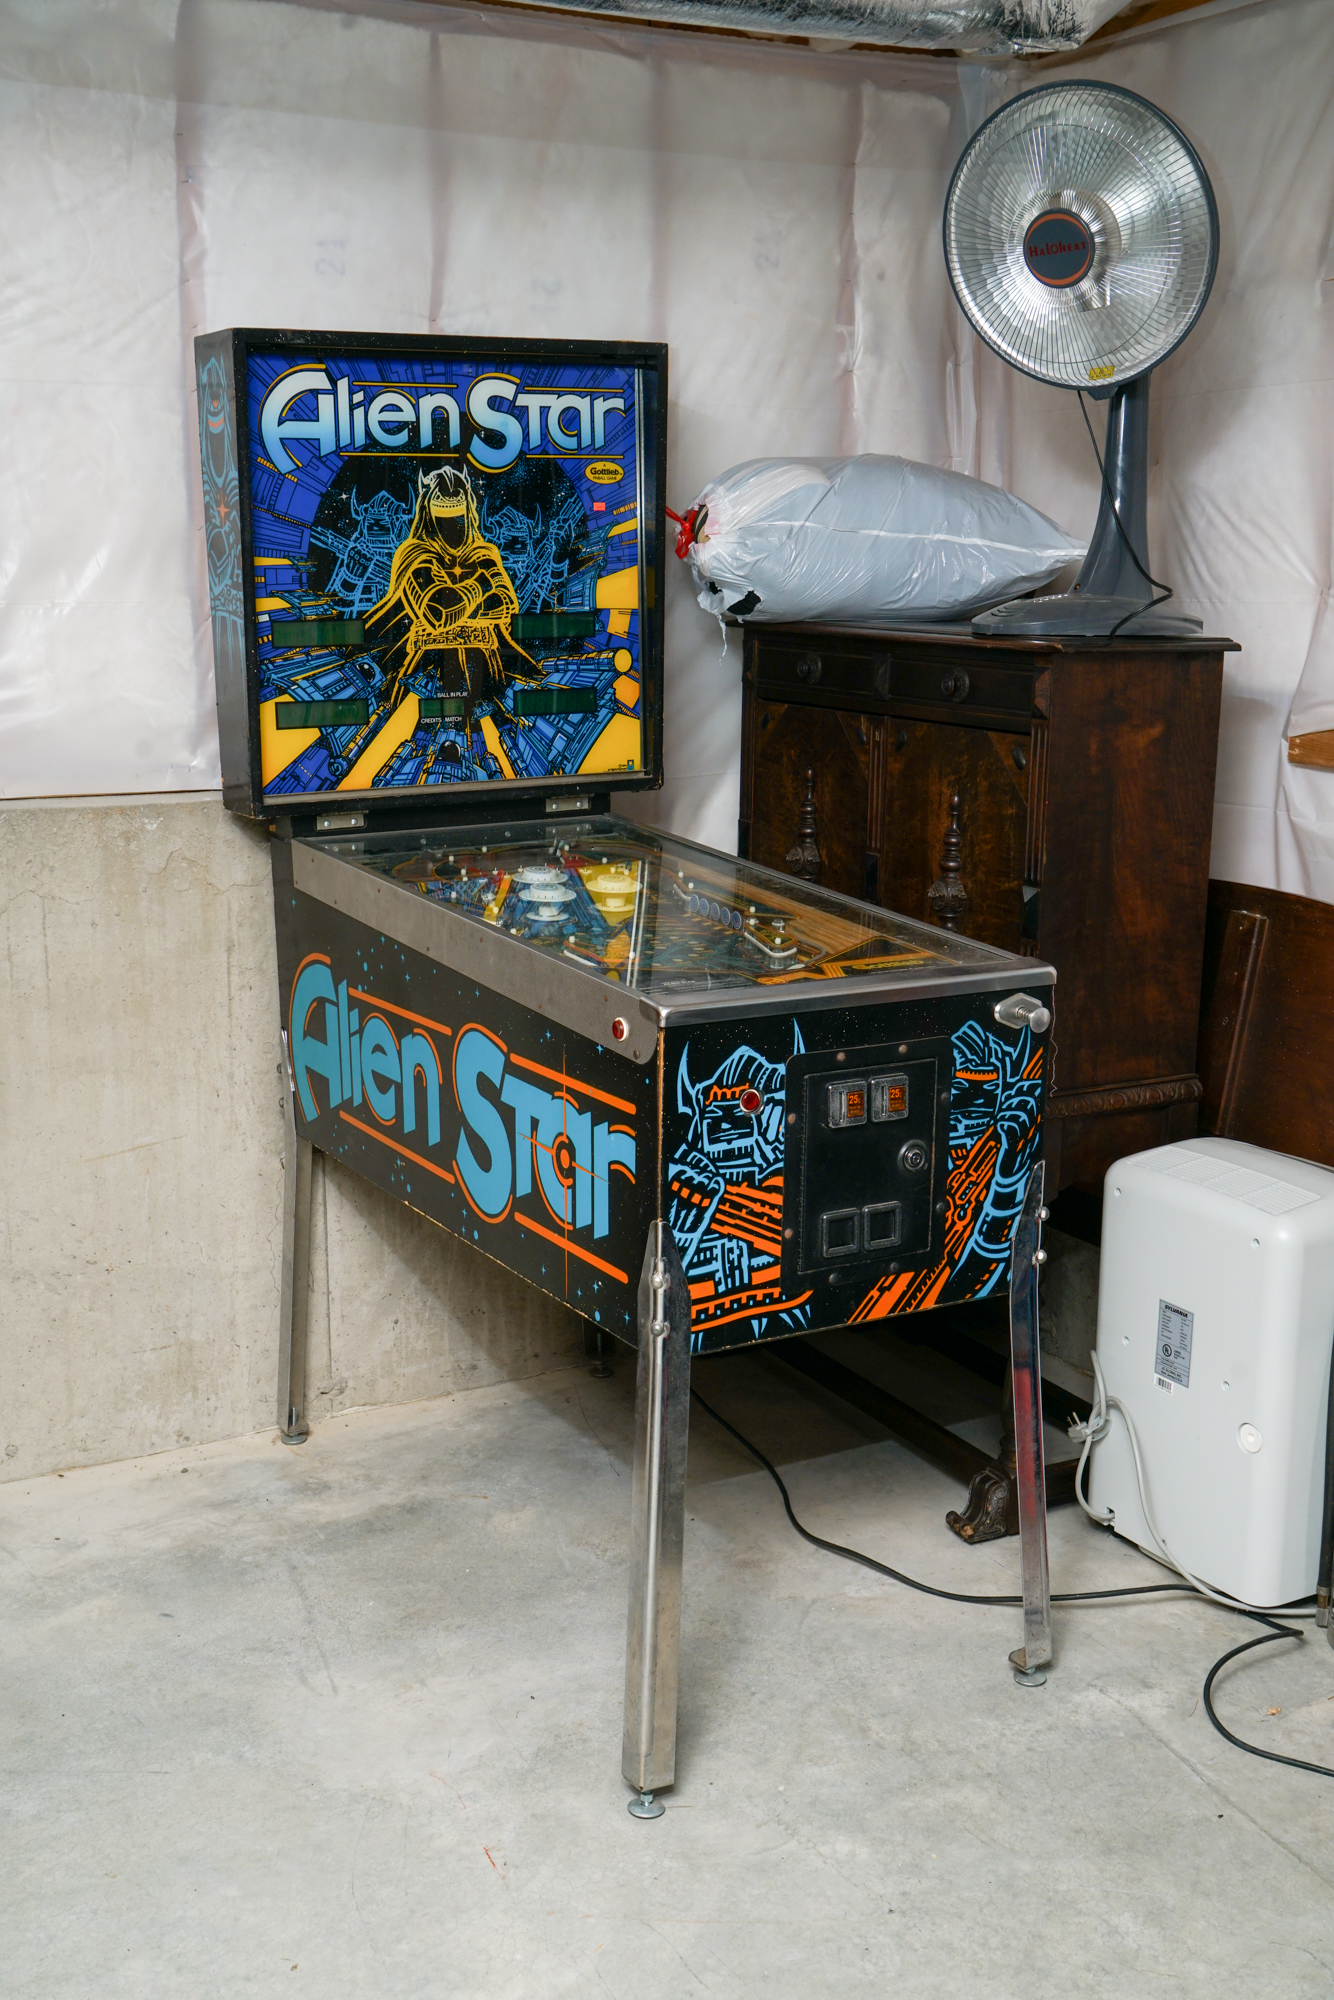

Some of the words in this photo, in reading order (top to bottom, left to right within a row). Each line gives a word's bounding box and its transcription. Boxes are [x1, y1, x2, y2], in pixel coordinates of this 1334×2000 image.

[261, 369, 462, 476] Alien
[590, 467, 619, 476] Gottlieb
[290, 962, 442, 1148] Alien
[1165, 1304, 1188, 1318] SYLVANIA
